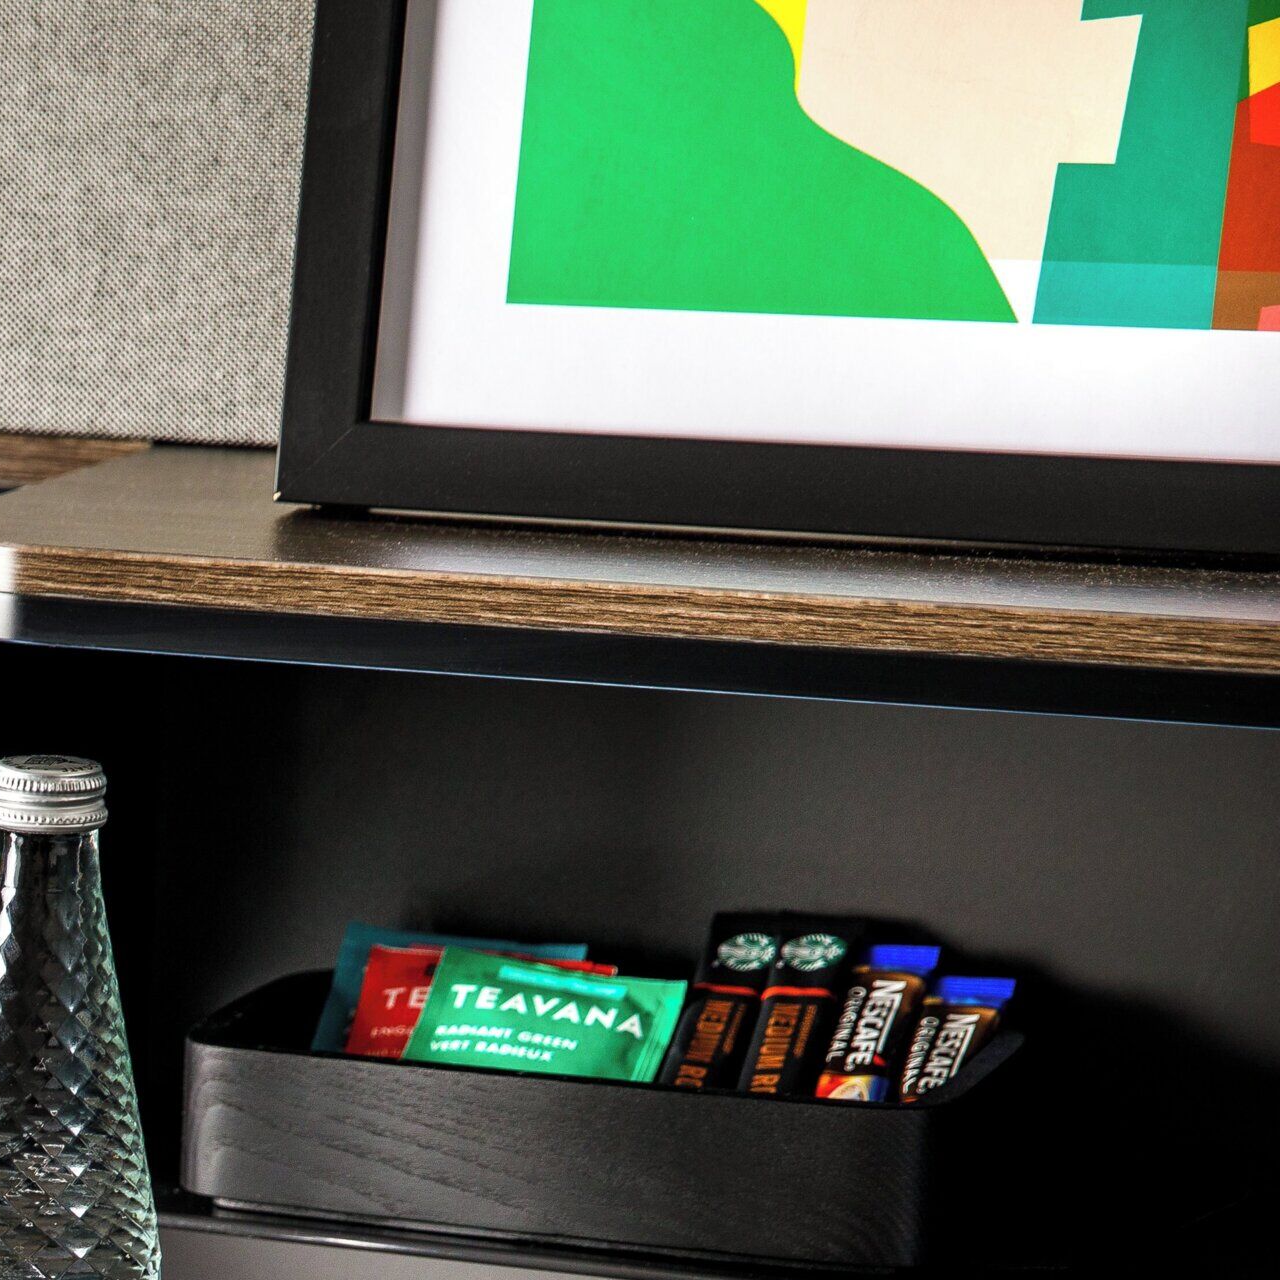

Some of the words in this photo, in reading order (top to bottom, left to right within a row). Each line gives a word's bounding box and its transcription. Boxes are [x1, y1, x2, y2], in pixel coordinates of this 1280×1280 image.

[434, 1024, 513, 1039] RADIANT
[517, 1030, 578, 1051] GREEN
[451, 983, 644, 1041] TEAVANA
[755, 1003, 802, 1070] MEDIUM
[825, 986, 867, 1063] ORIGINAL
[430, 1039, 471, 1052] VERT
[475, 1040, 554, 1062] RADIEUX
[903, 1016, 939, 1093] ORIGINAL
